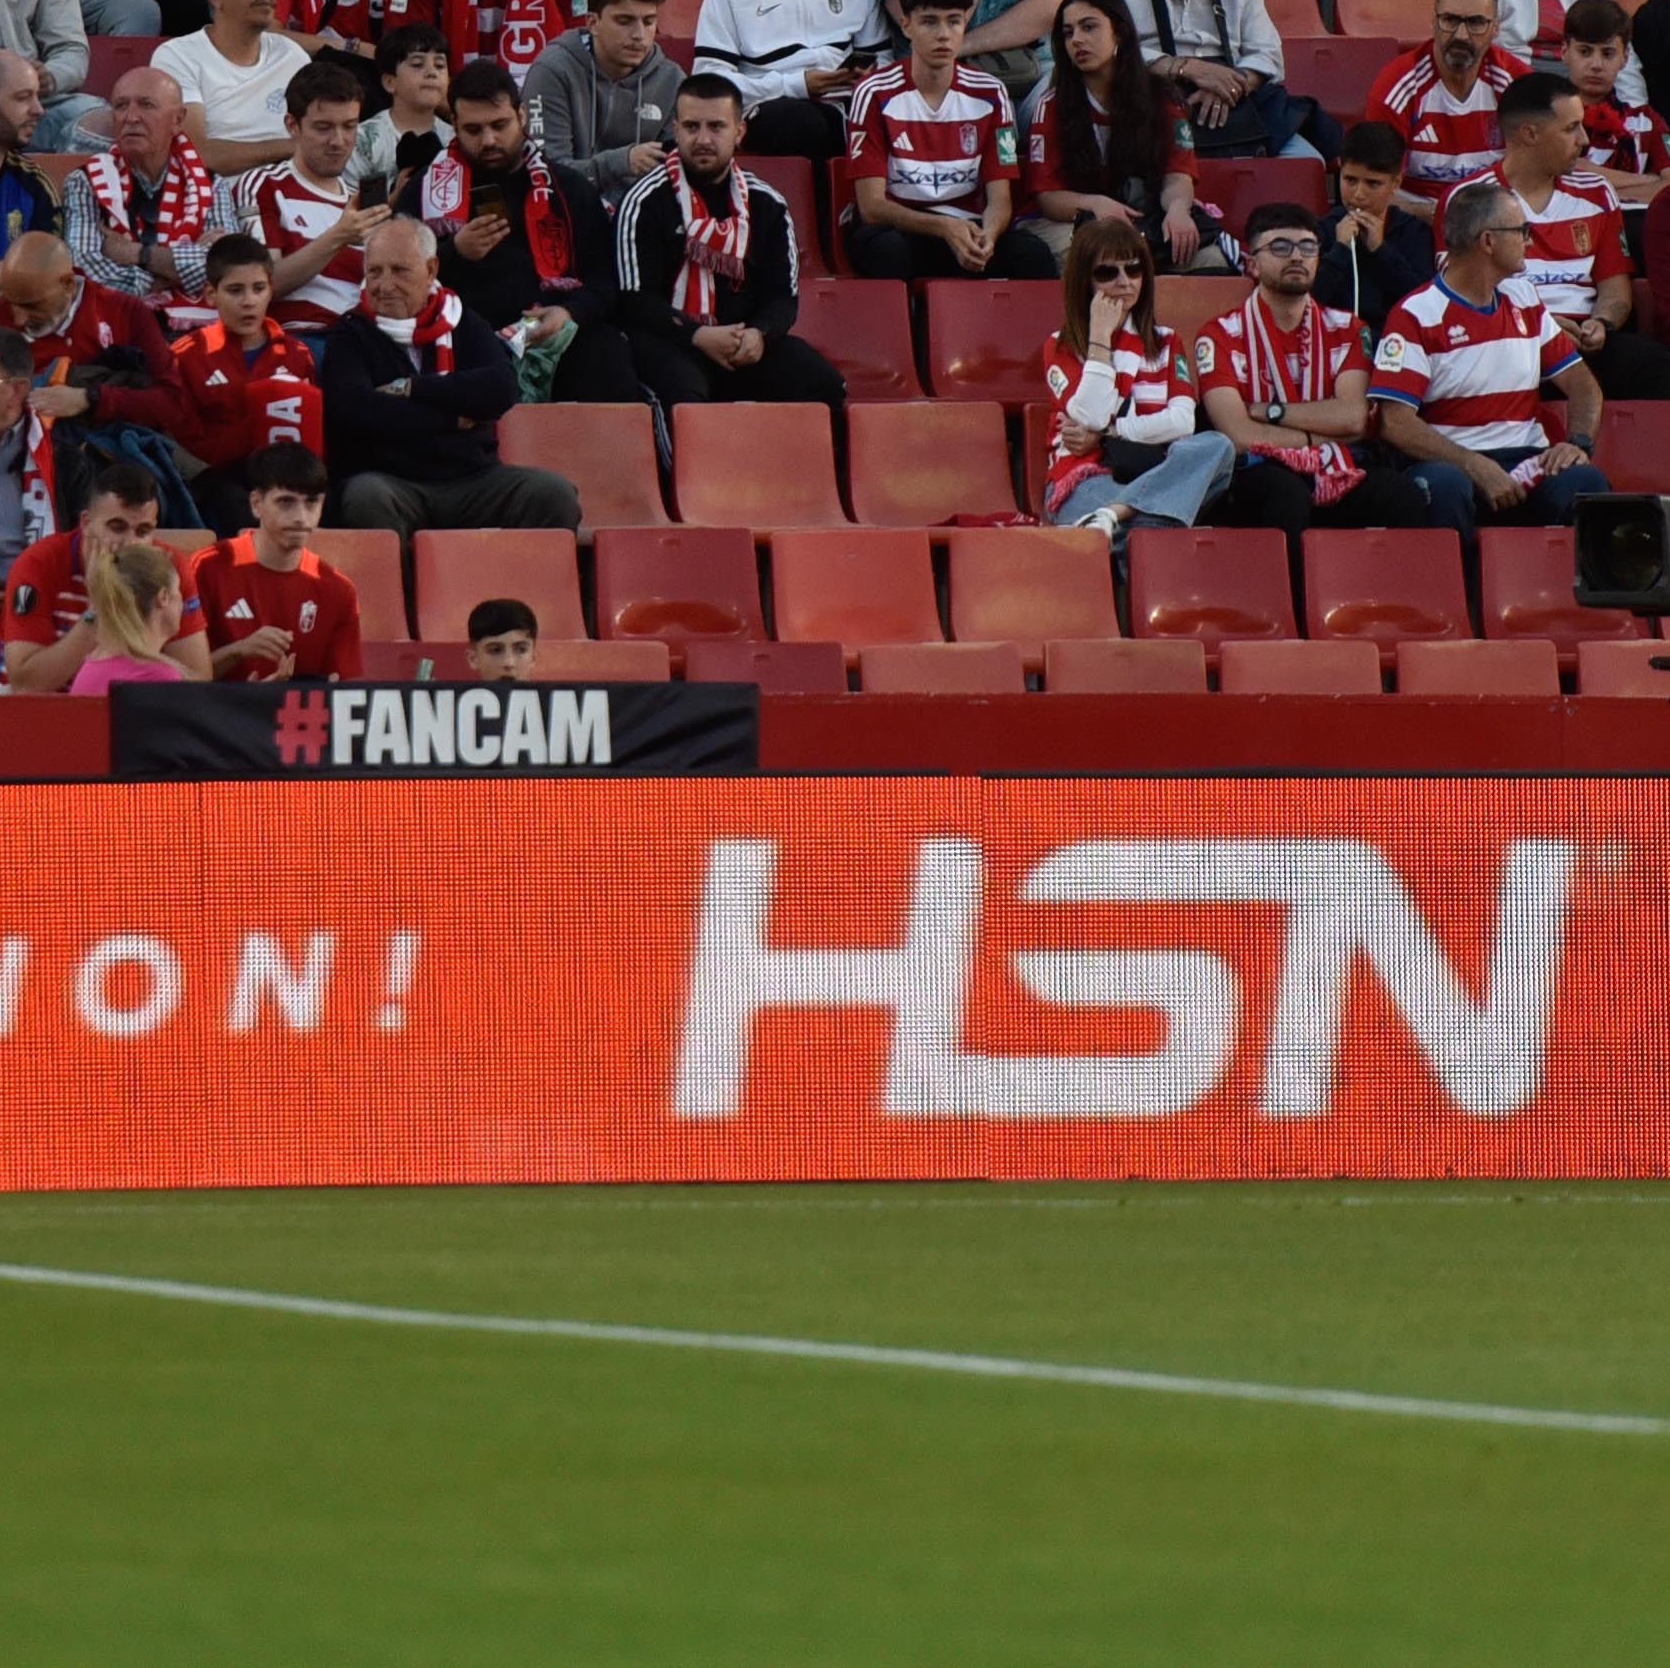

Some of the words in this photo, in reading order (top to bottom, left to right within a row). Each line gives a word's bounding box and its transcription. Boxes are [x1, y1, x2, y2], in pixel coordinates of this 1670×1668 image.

[529, 94, 545, 136] THE
[275, 687, 612, 765] #FANCAM
[673, 838, 1577, 1119] HSN
